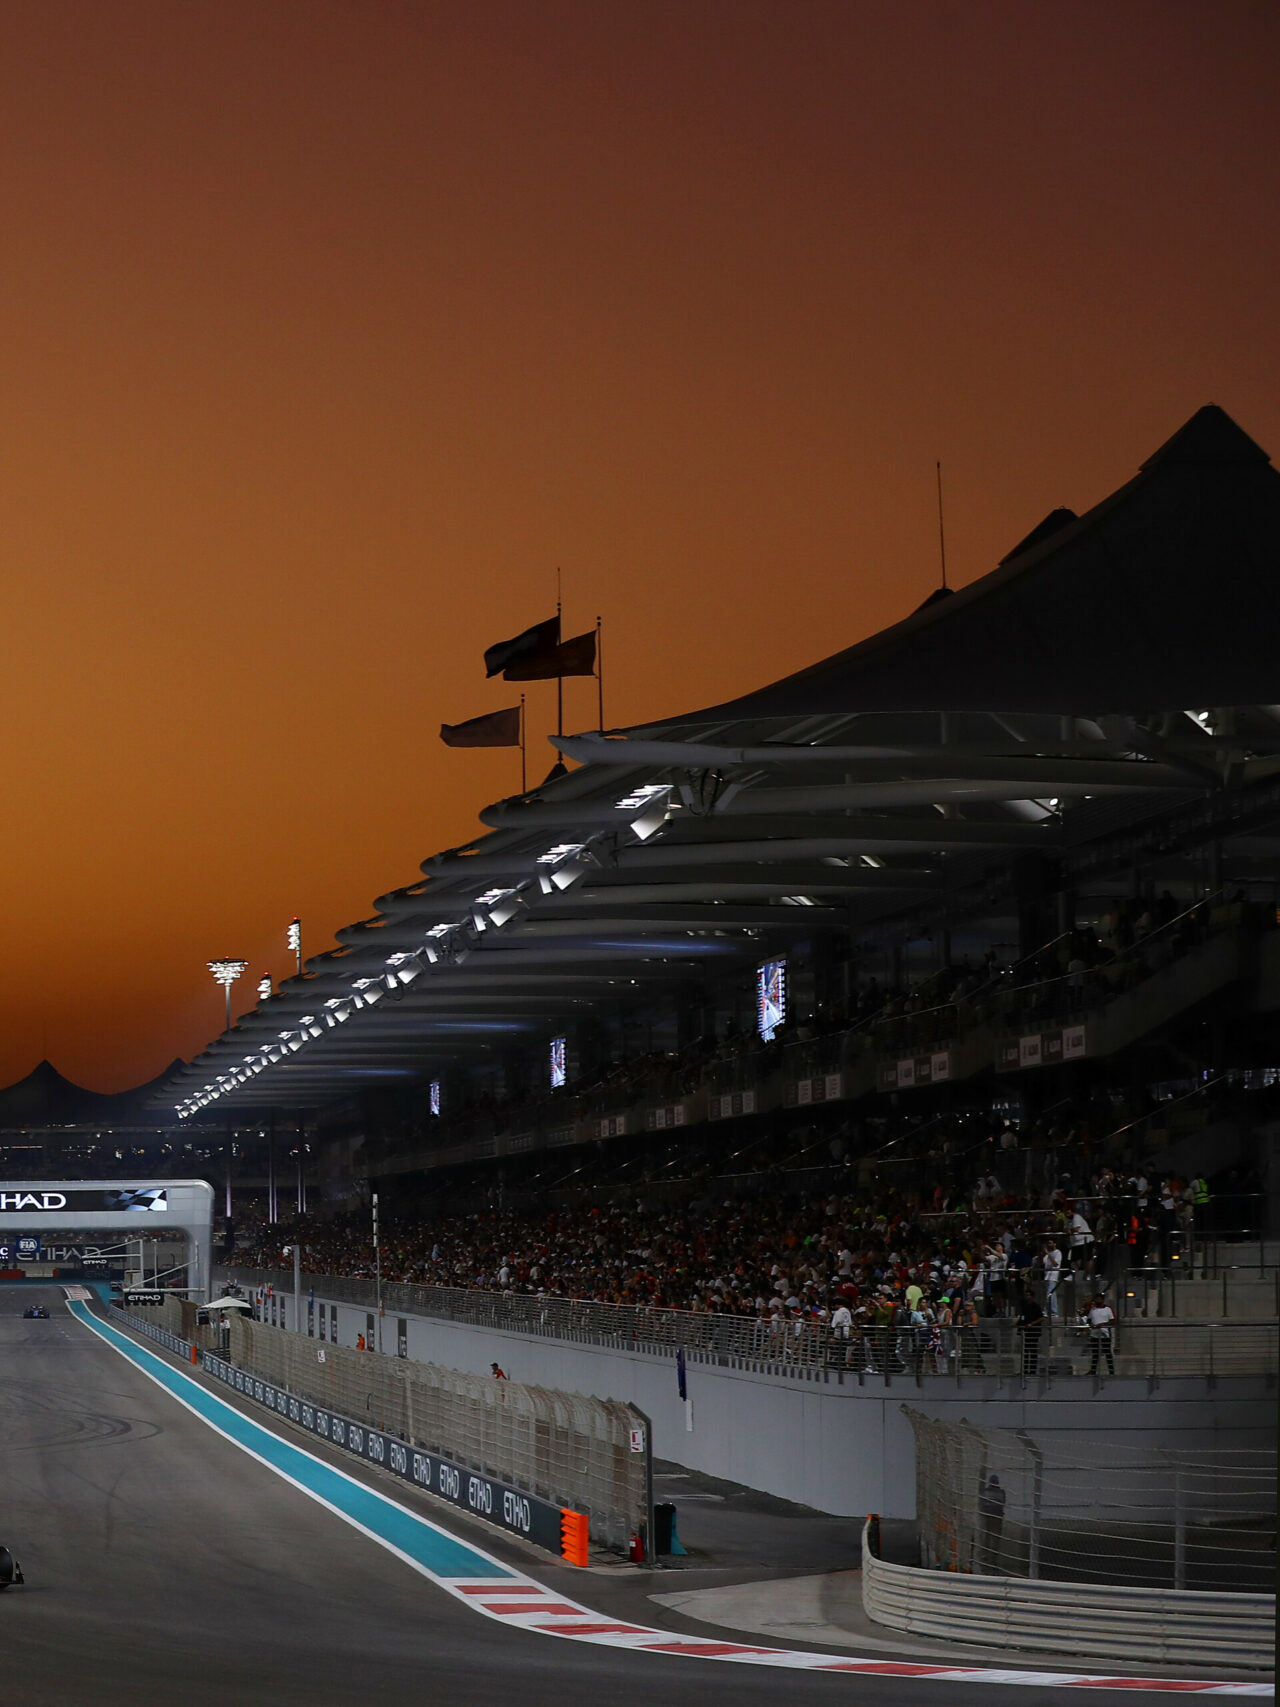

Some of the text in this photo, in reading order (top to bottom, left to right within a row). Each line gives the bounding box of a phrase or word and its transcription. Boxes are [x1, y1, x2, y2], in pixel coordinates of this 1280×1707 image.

[368, 1433, 385, 1462] ETIHAD
[390, 1443, 407, 1474] ETIHAD
[413, 1454, 431, 1485] ETIHAD
[440, 1464, 460, 1499] ETIHAD
[469, 1477, 493, 1514] ETIHAD
[503, 1490, 531, 1532] ETIHAD
